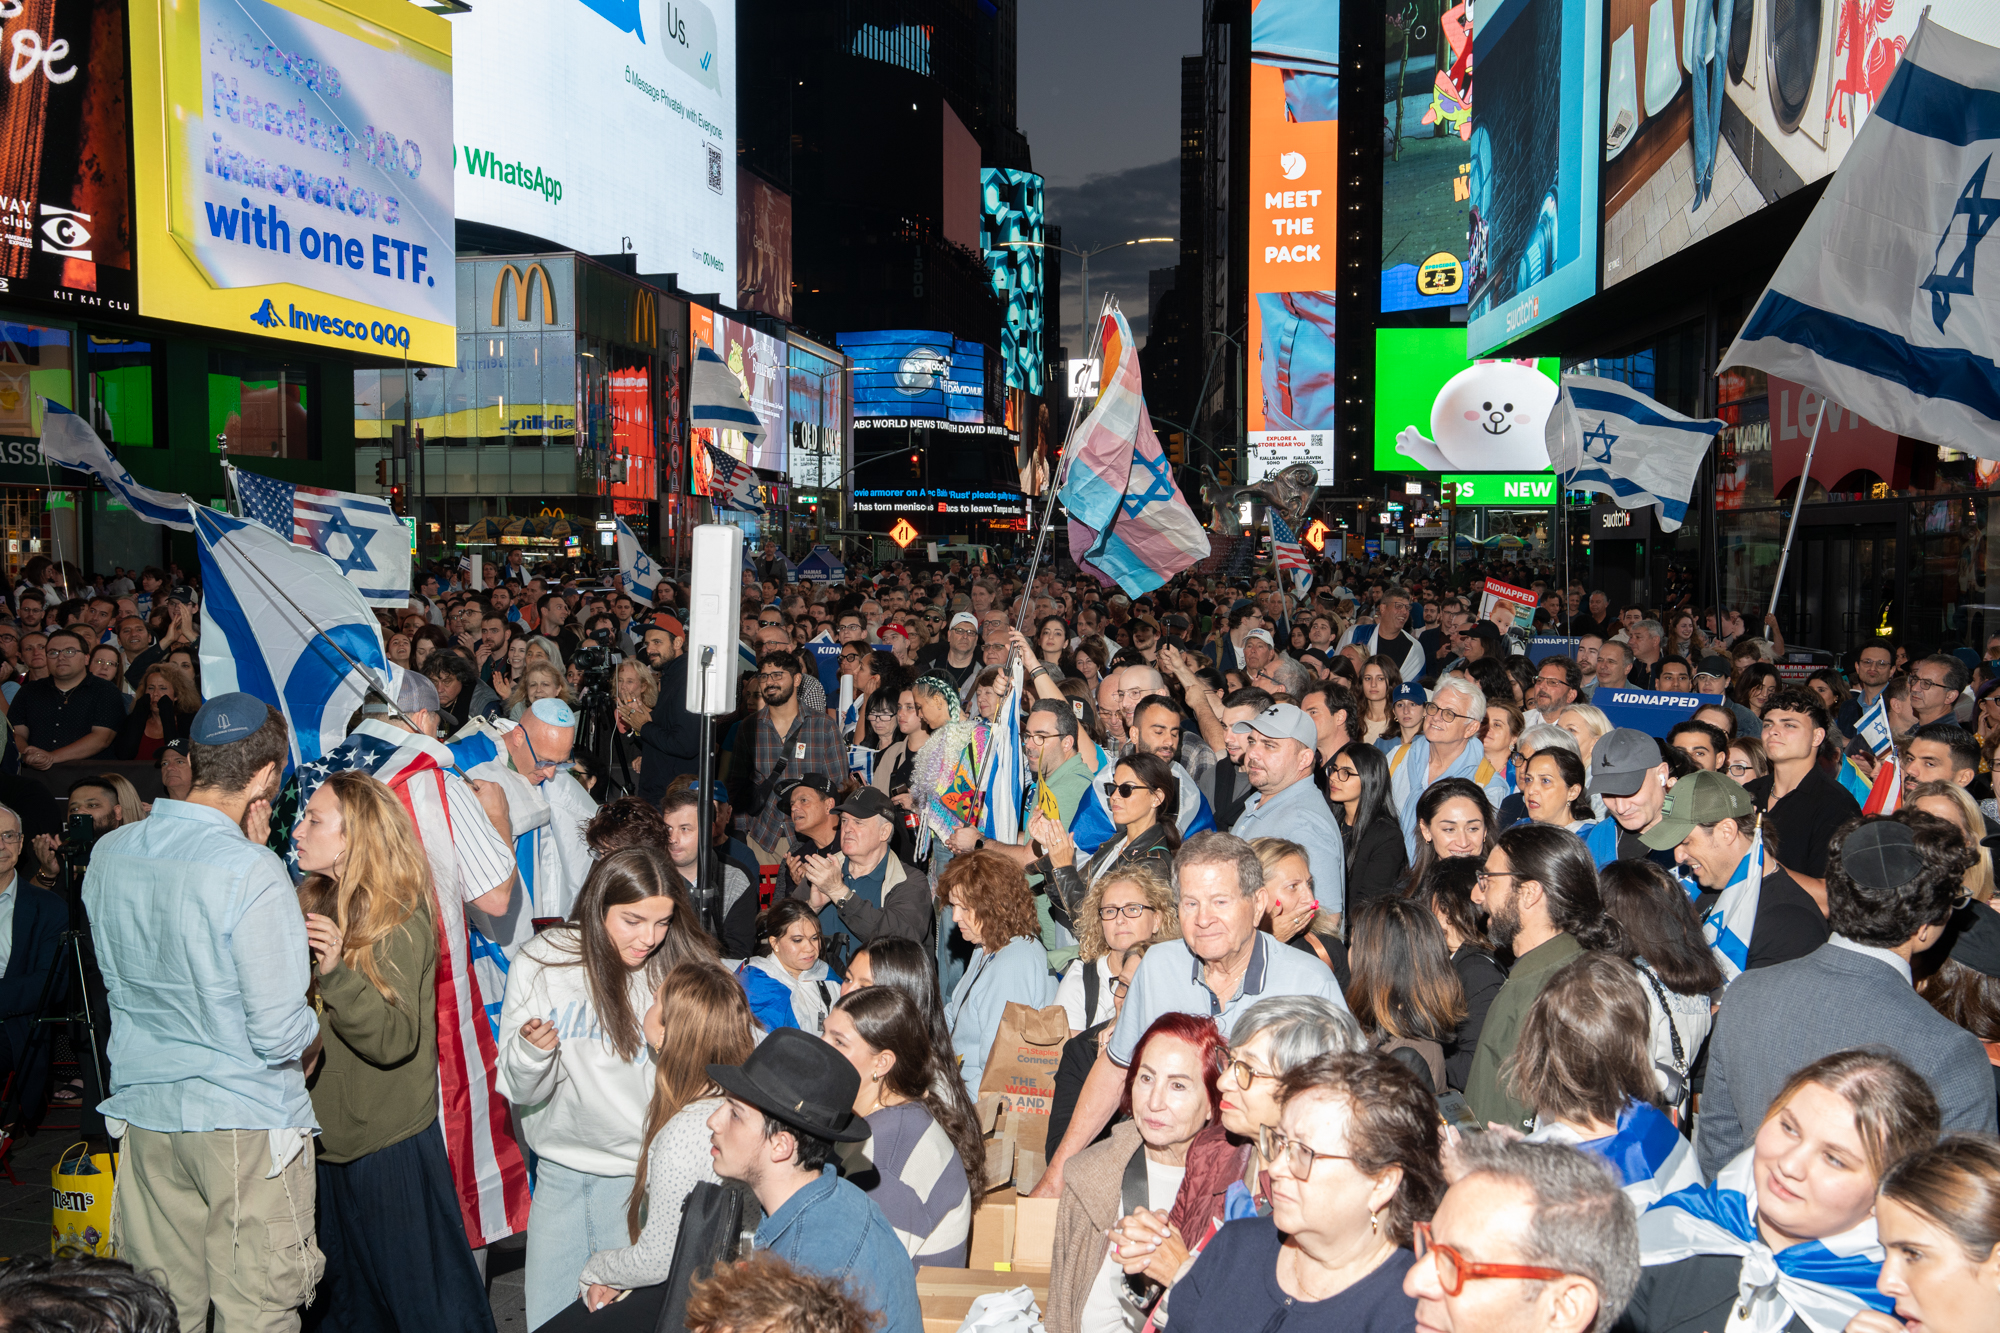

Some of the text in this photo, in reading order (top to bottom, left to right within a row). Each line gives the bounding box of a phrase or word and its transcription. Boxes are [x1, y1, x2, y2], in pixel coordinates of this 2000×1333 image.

[667, 2, 689, 48] Us.
[632, 70, 660, 102] Message
[660, 88, 686, 120] Privately
[698, 112, 724, 140] Everyone.
[211, 71, 422, 179] Nasdaq-100
[463, 145, 562, 206] WhatsApp
[1265, 189, 1322, 210] MEET
[3, 214, 32, 230] club
[1272, 217, 1314, 236] THE
[205, 197, 435, 288] with one ETF.
[1265, 244, 1321, 264] PACK
[710, 254, 724, 272] Meta
[53, 290, 73, 301] KIT
[81, 295, 101, 306] KAT
[288, 303, 410, 350] Invesco QQQ
[947, 385, 970, 394] DAVID
[801, 420, 818, 450] OLD
[853, 419, 871, 429] ABC
[872, 419, 908, 429] WORLD
[909, 419, 935, 430] NEWS
[958, 424, 986, 434] DAVID
[987, 425, 1003, 435] MUIR
[870, 489, 905, 497] armorer
[905, 489, 918, 497] on
[948, 490, 971, 499] 'Rust'
[971, 490, 997, 501] pleads
[1504, 481, 1553, 498] NEW
[859, 502, 873, 511] has
[874, 502, 892, 511] torn
[960, 504, 969, 512] to
[970, 503, 992, 513] leave
[1486, 581, 1535, 603] KIDNAPPED
[1612, 692, 1699, 708] KIDNAPPED
[1017, 1054, 1059, 1065] Connect
[1030, 1048, 1059, 1057] Staples
[1010, 1076, 1037, 1087] THE
[1016, 1096, 1045, 1108] AND
